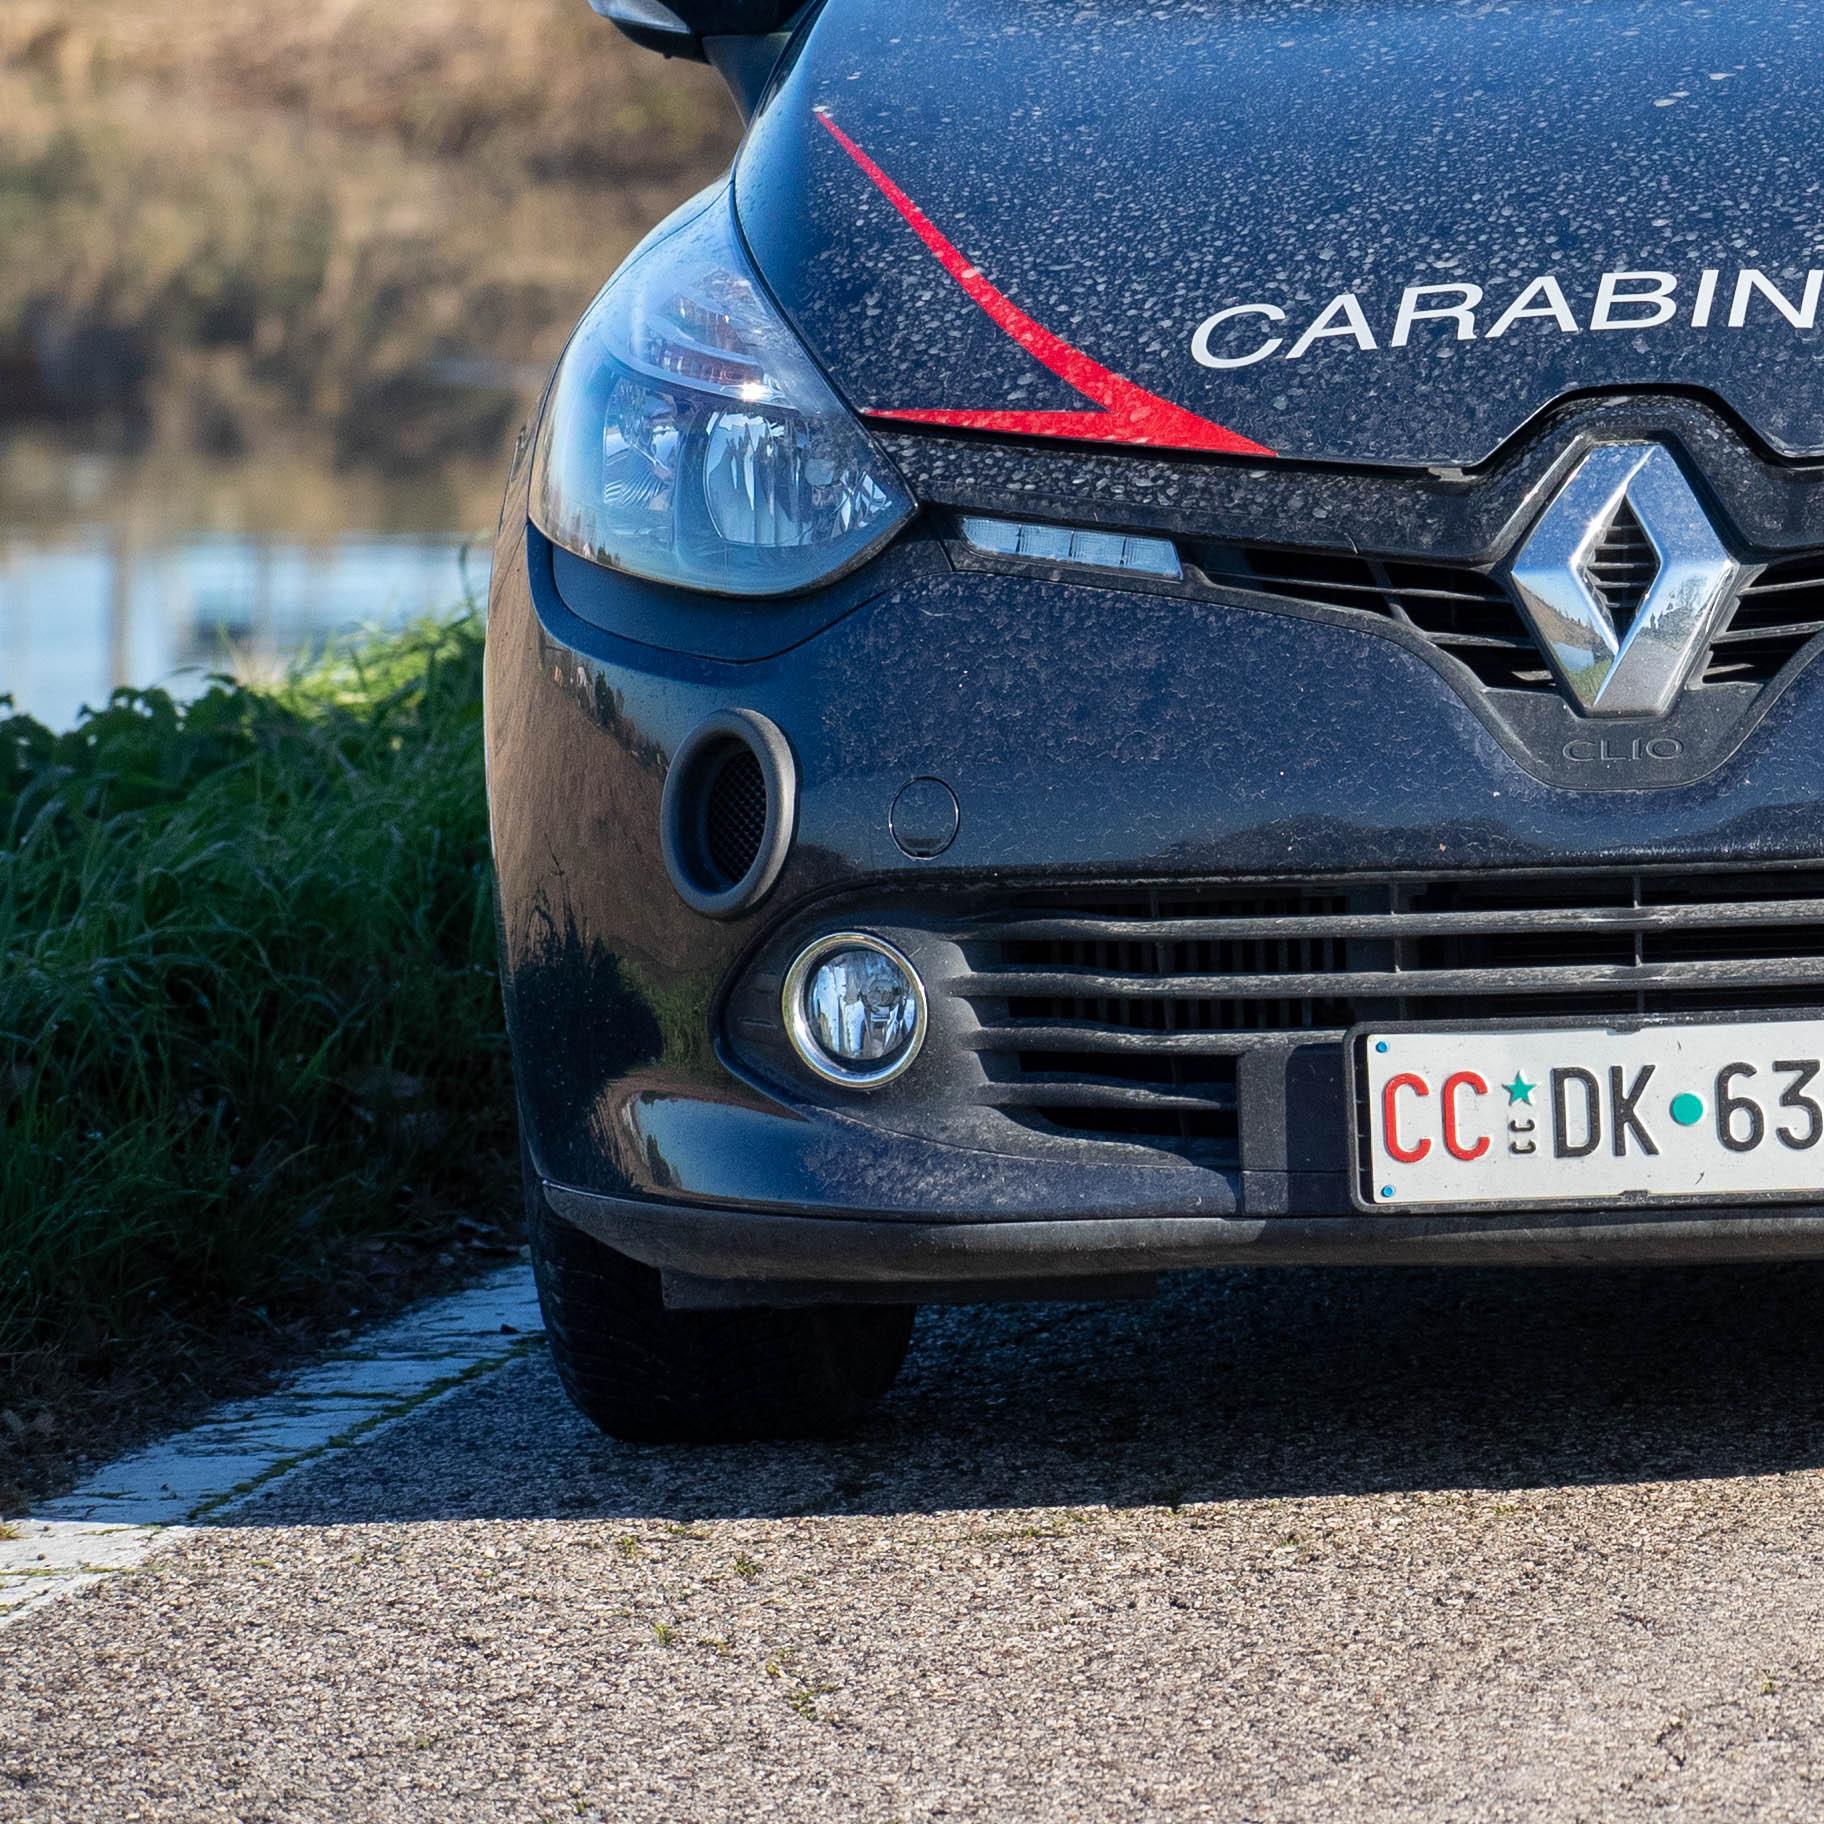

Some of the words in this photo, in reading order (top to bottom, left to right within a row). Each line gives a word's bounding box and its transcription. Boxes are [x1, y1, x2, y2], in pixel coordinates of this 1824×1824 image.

[1562, 736, 1685, 762] CLIO
[1379, 1071, 1492, 1164] CC
[1549, 1063, 1661, 1158] DK
